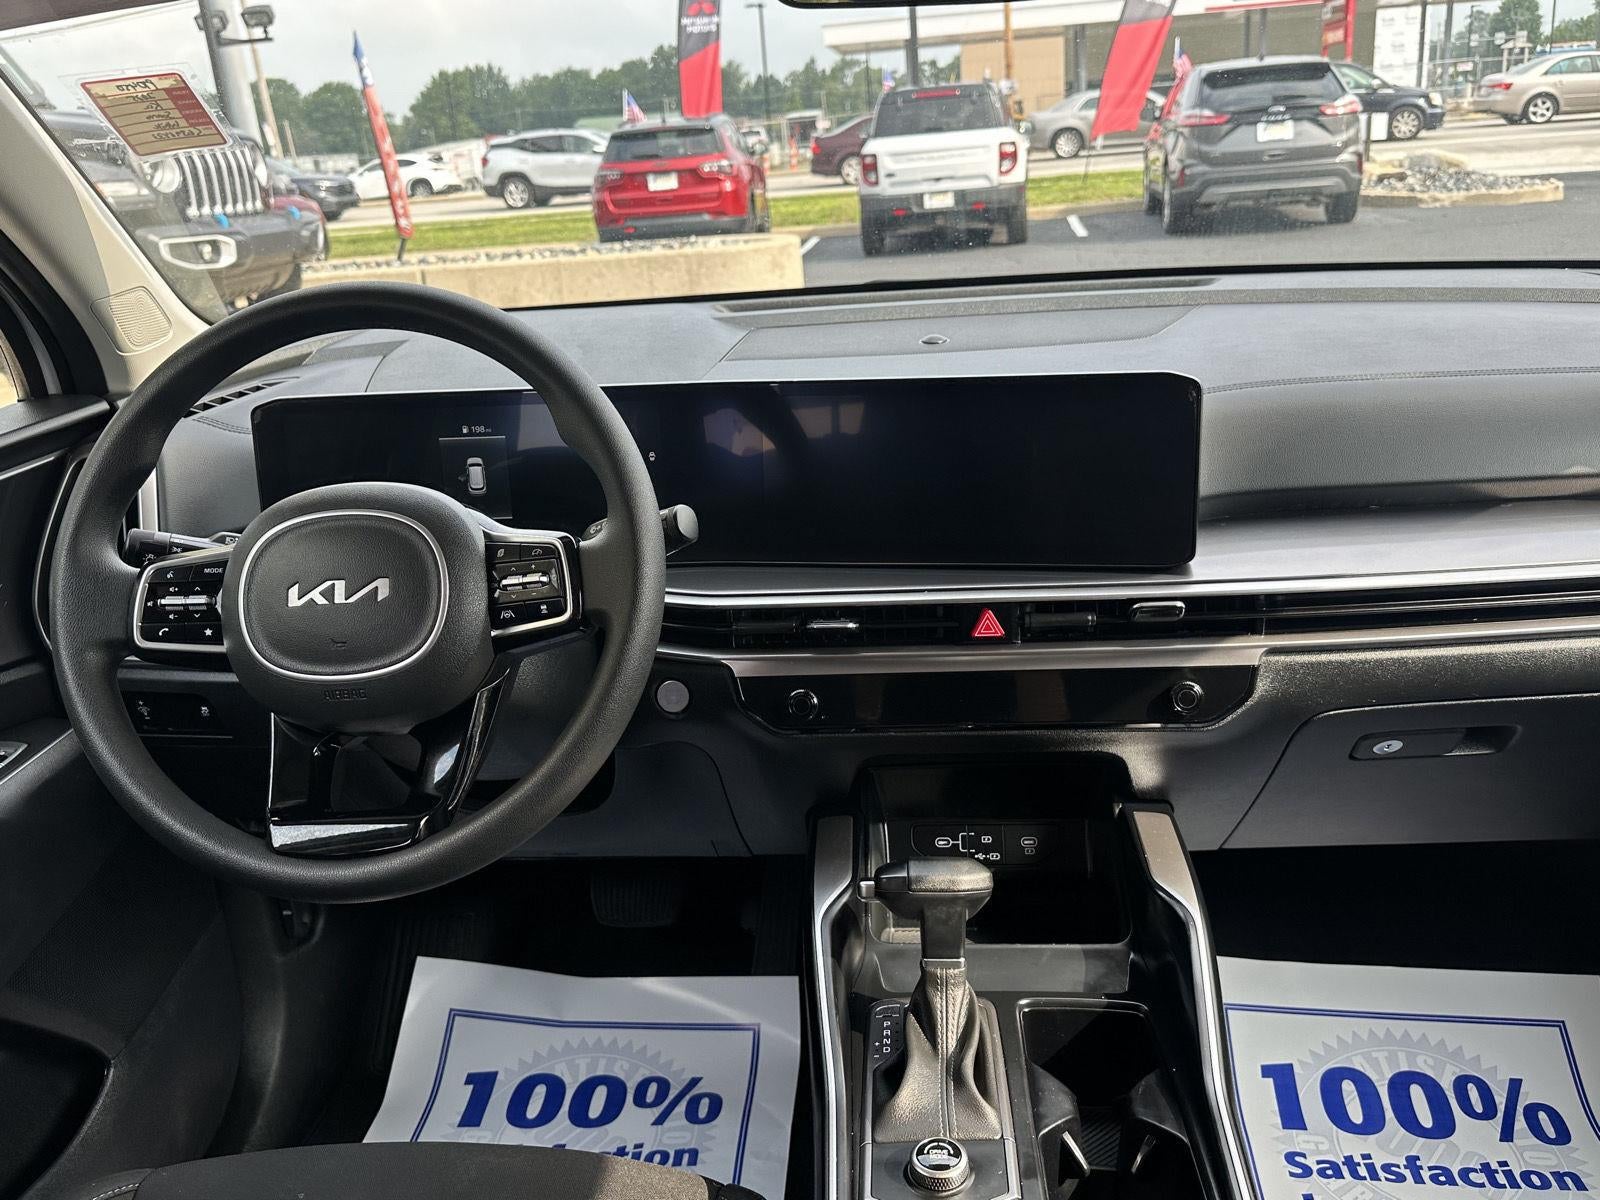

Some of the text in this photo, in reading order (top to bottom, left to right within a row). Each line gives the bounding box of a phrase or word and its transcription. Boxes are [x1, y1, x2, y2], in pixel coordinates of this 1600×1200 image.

[471, 425, 485, 433] 198
[287, 577, 390, 607] KIA
[323, 689, 367, 701] AIRBAG
[457, 1070, 723, 1129] 100%
[1261, 1063, 1572, 1146] 100%
[1283, 1150, 1590, 1192] Satisfaction
